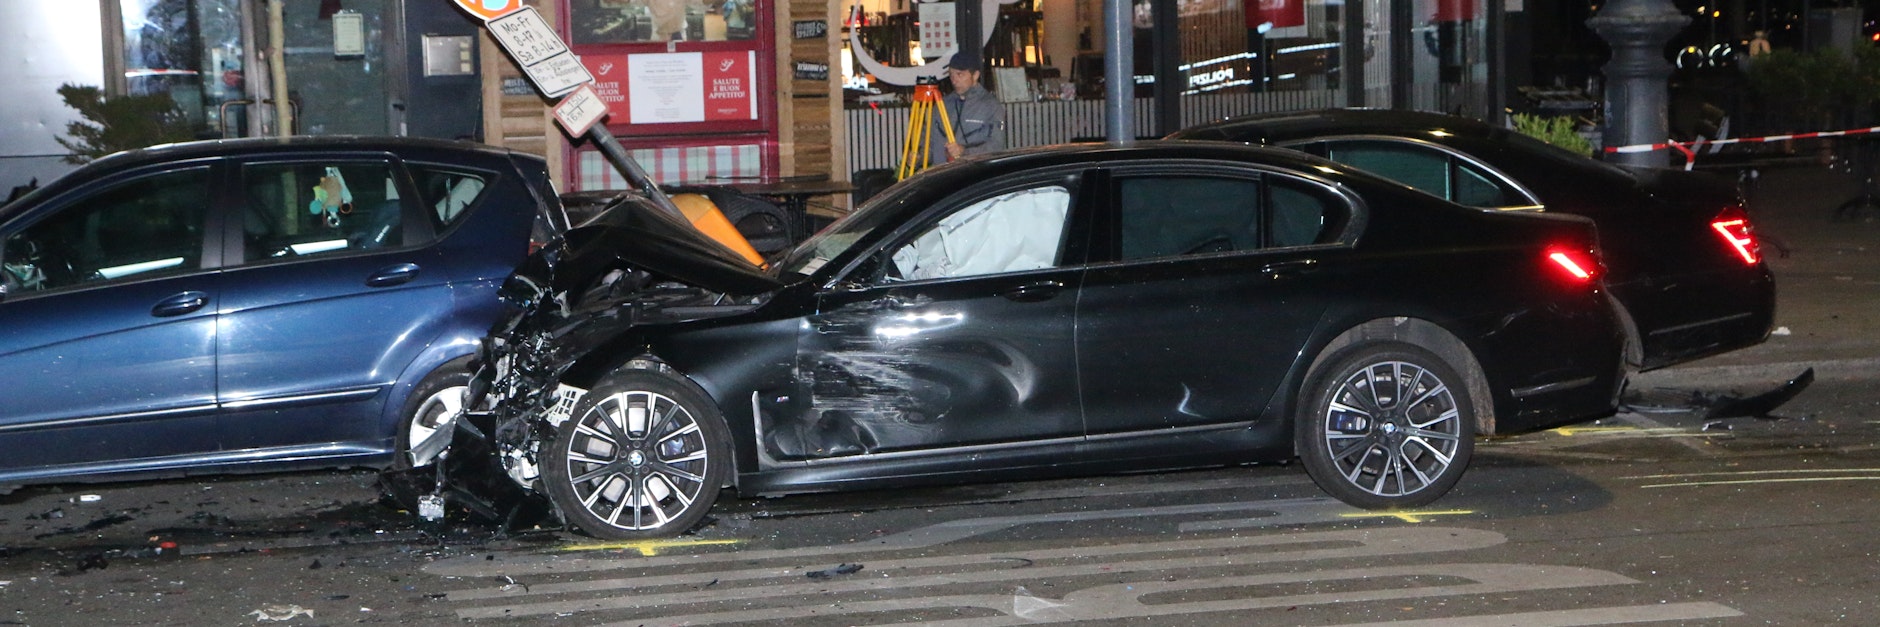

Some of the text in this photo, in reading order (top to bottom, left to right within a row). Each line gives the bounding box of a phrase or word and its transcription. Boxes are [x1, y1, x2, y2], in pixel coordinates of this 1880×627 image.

[500, 17, 532, 33] Mo-Fr
[513, 31, 535, 47] 8-17
[518, 50, 535, 62] Sa
[531, 40, 555, 57] 8-14
[595, 81, 619, 89] ALUTE
[713, 78, 741, 86] SALUTE
[708, 91, 746, 99] APPETITO!
